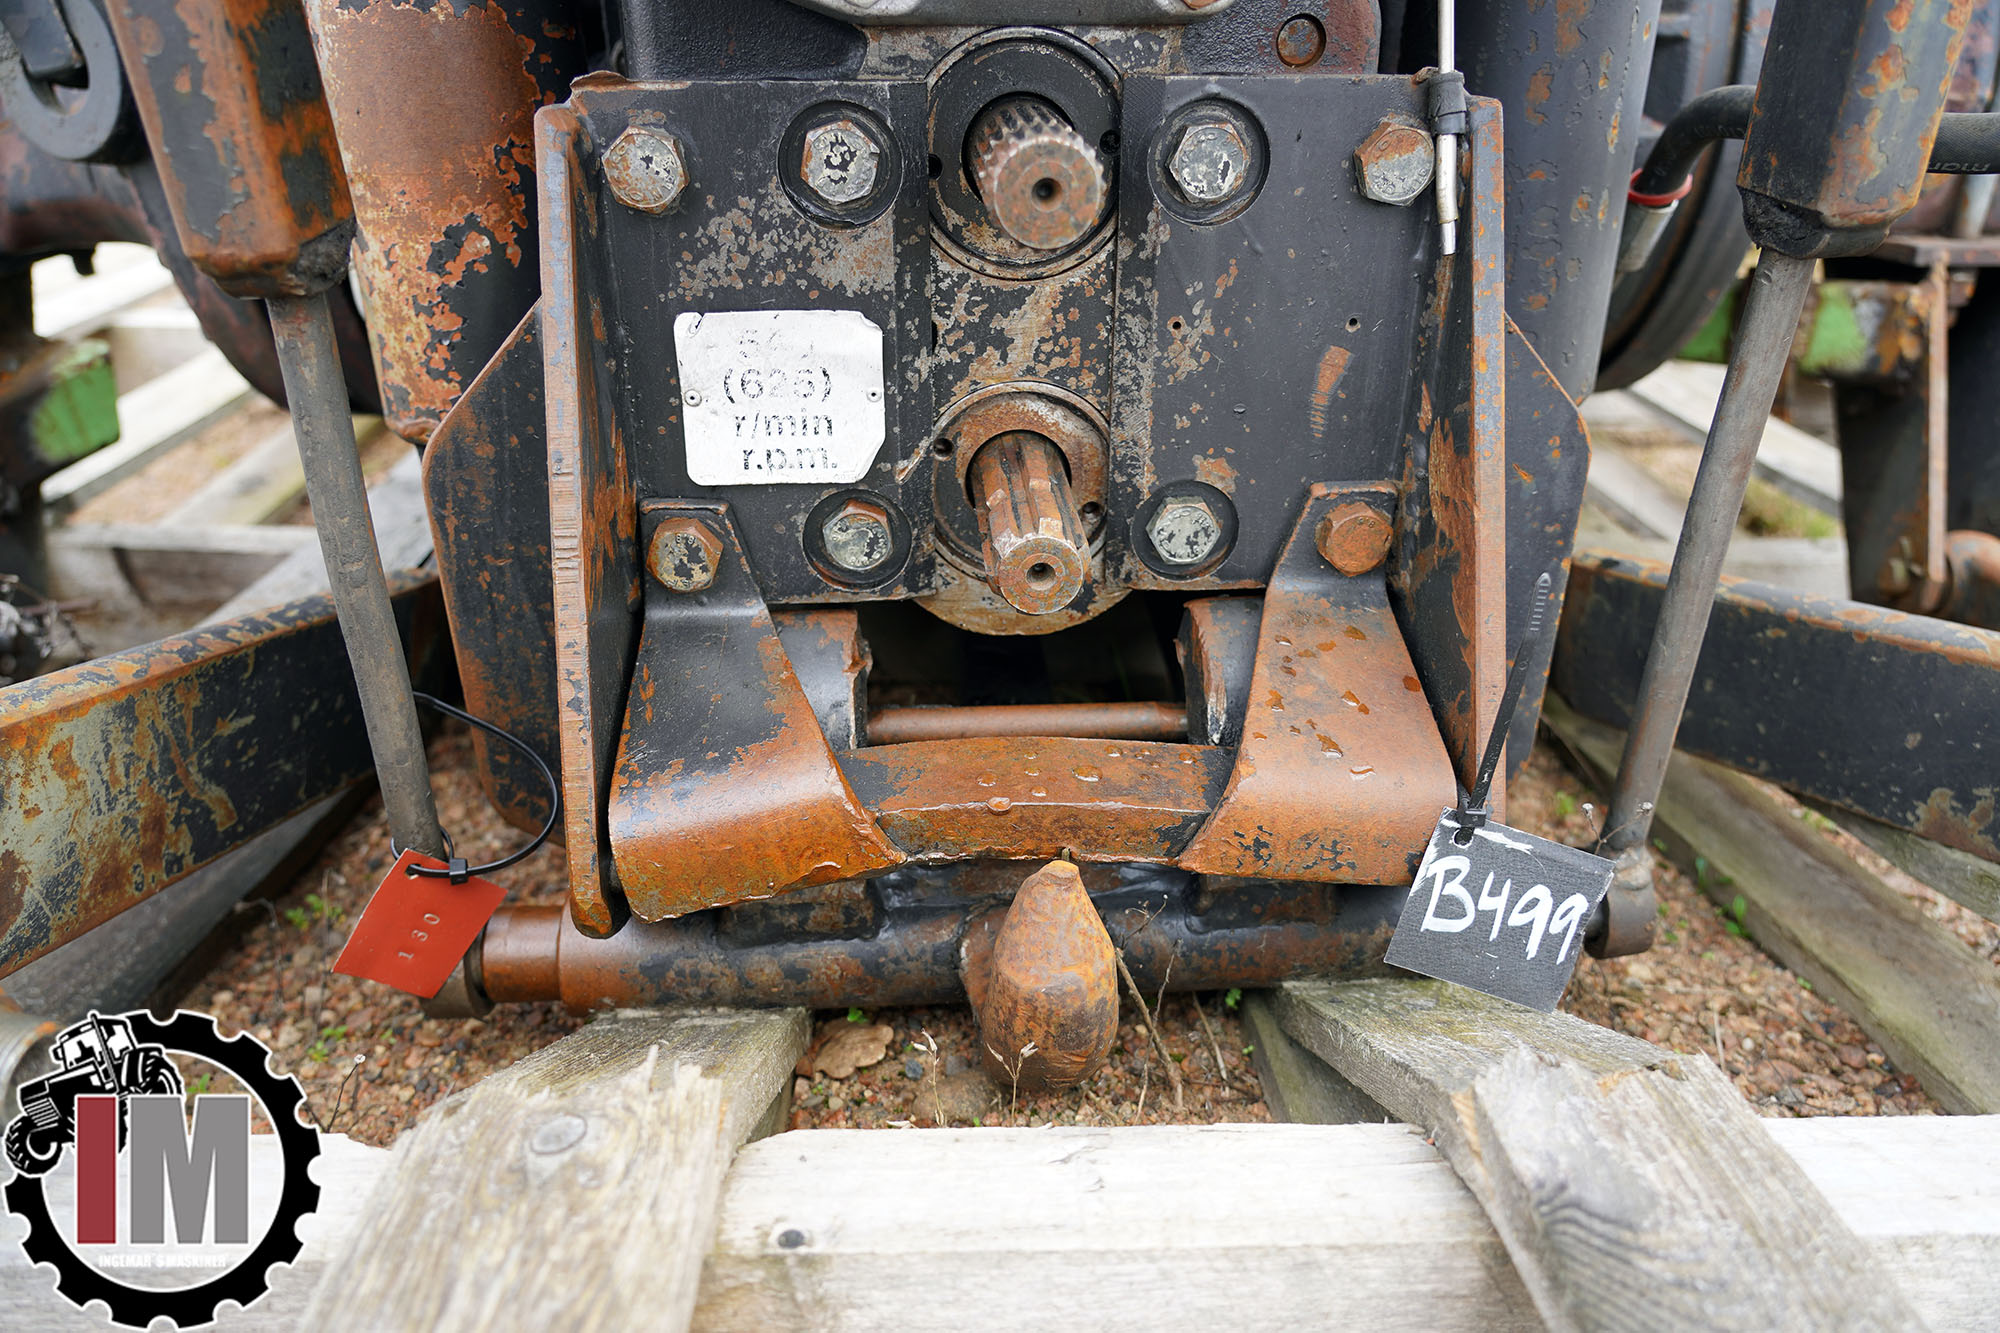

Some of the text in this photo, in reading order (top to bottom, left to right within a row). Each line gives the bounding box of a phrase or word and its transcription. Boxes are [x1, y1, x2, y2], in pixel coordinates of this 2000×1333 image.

[734, 407, 834, 438] r/min
[742, 446, 838, 475] r.p.m.
[1419, 854, 1591, 966] B499
[397, 912, 441, 961] 130
